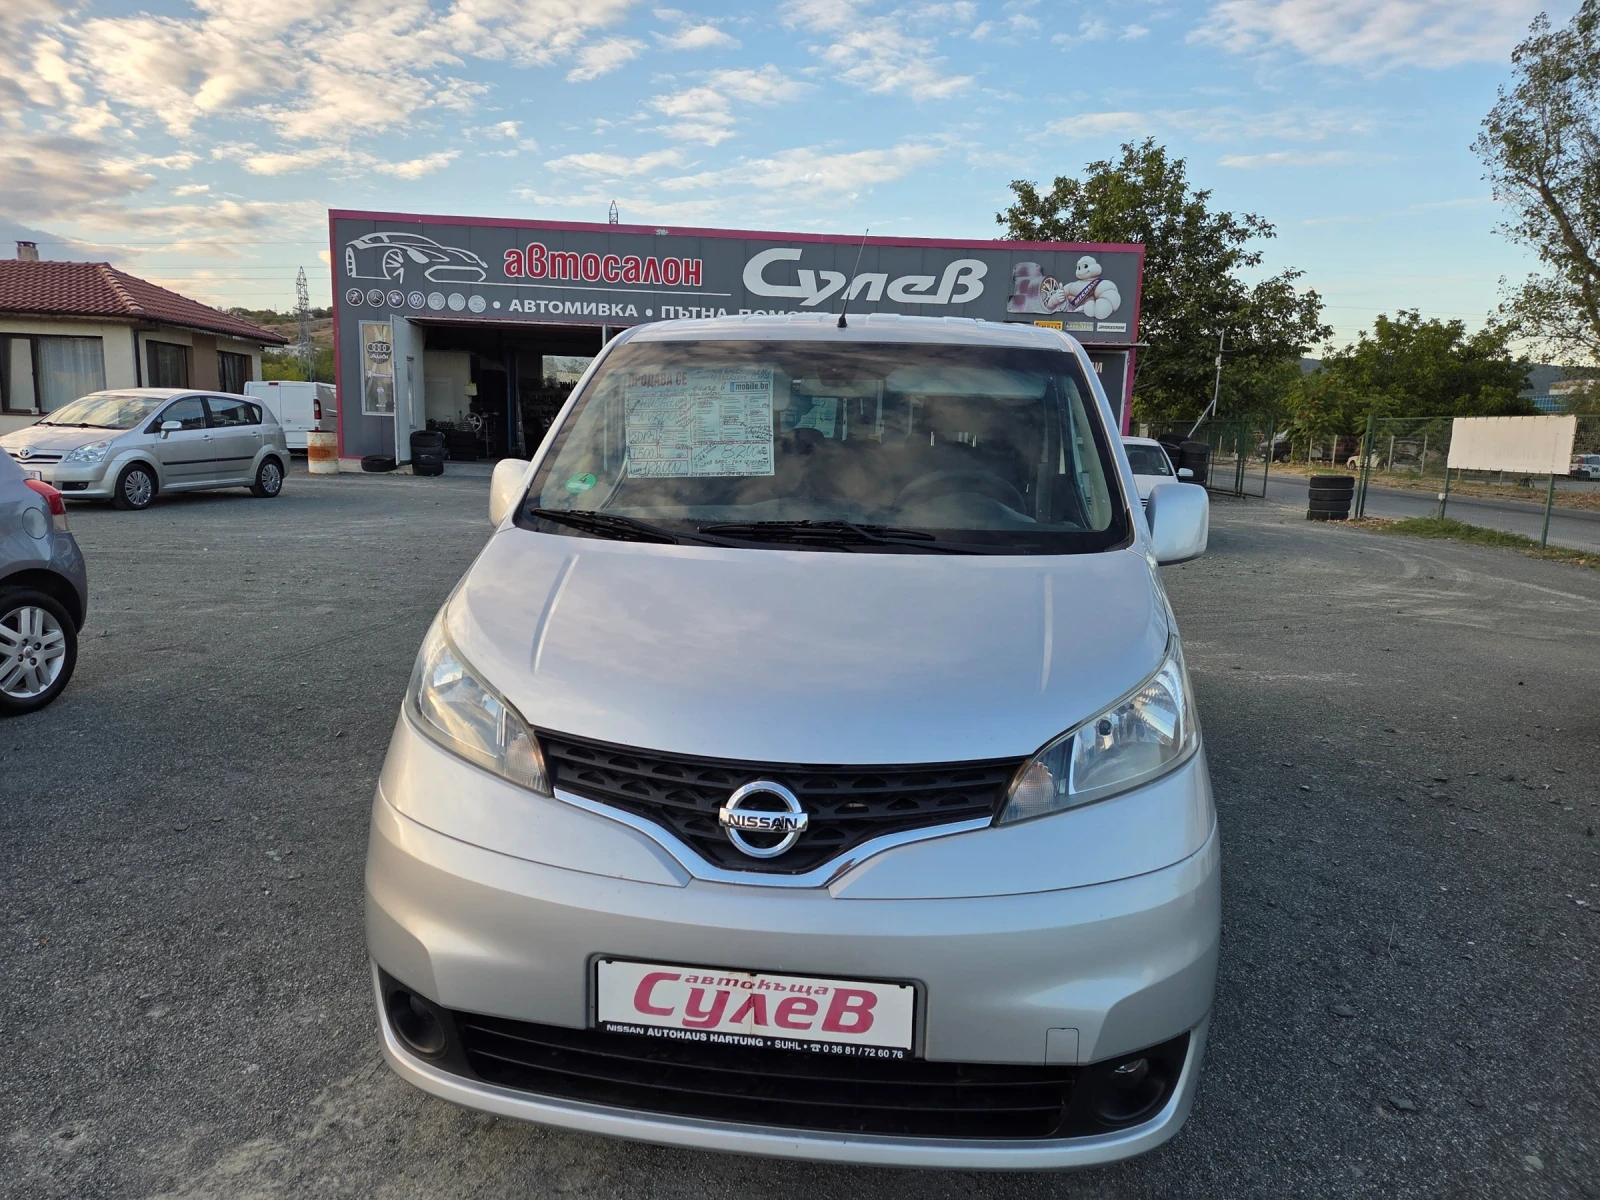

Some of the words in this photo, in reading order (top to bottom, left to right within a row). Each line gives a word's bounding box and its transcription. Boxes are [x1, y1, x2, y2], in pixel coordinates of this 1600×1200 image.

[504, 242, 703, 287] автосалон
[508, 299, 638, 317] АВТОМИВКА
[735, 382, 769, 391] mobile.bg
[728, 813, 798, 830] NISSAN
[684, 974, 829, 996] автокъща
[606, 1024, 644, 1035] NISSAN
[646, 1027, 707, 1042] AUTOHAUS
[709, 1033, 764, 1047] HARTUNG
[774, 1039, 801, 1051] SUHL
